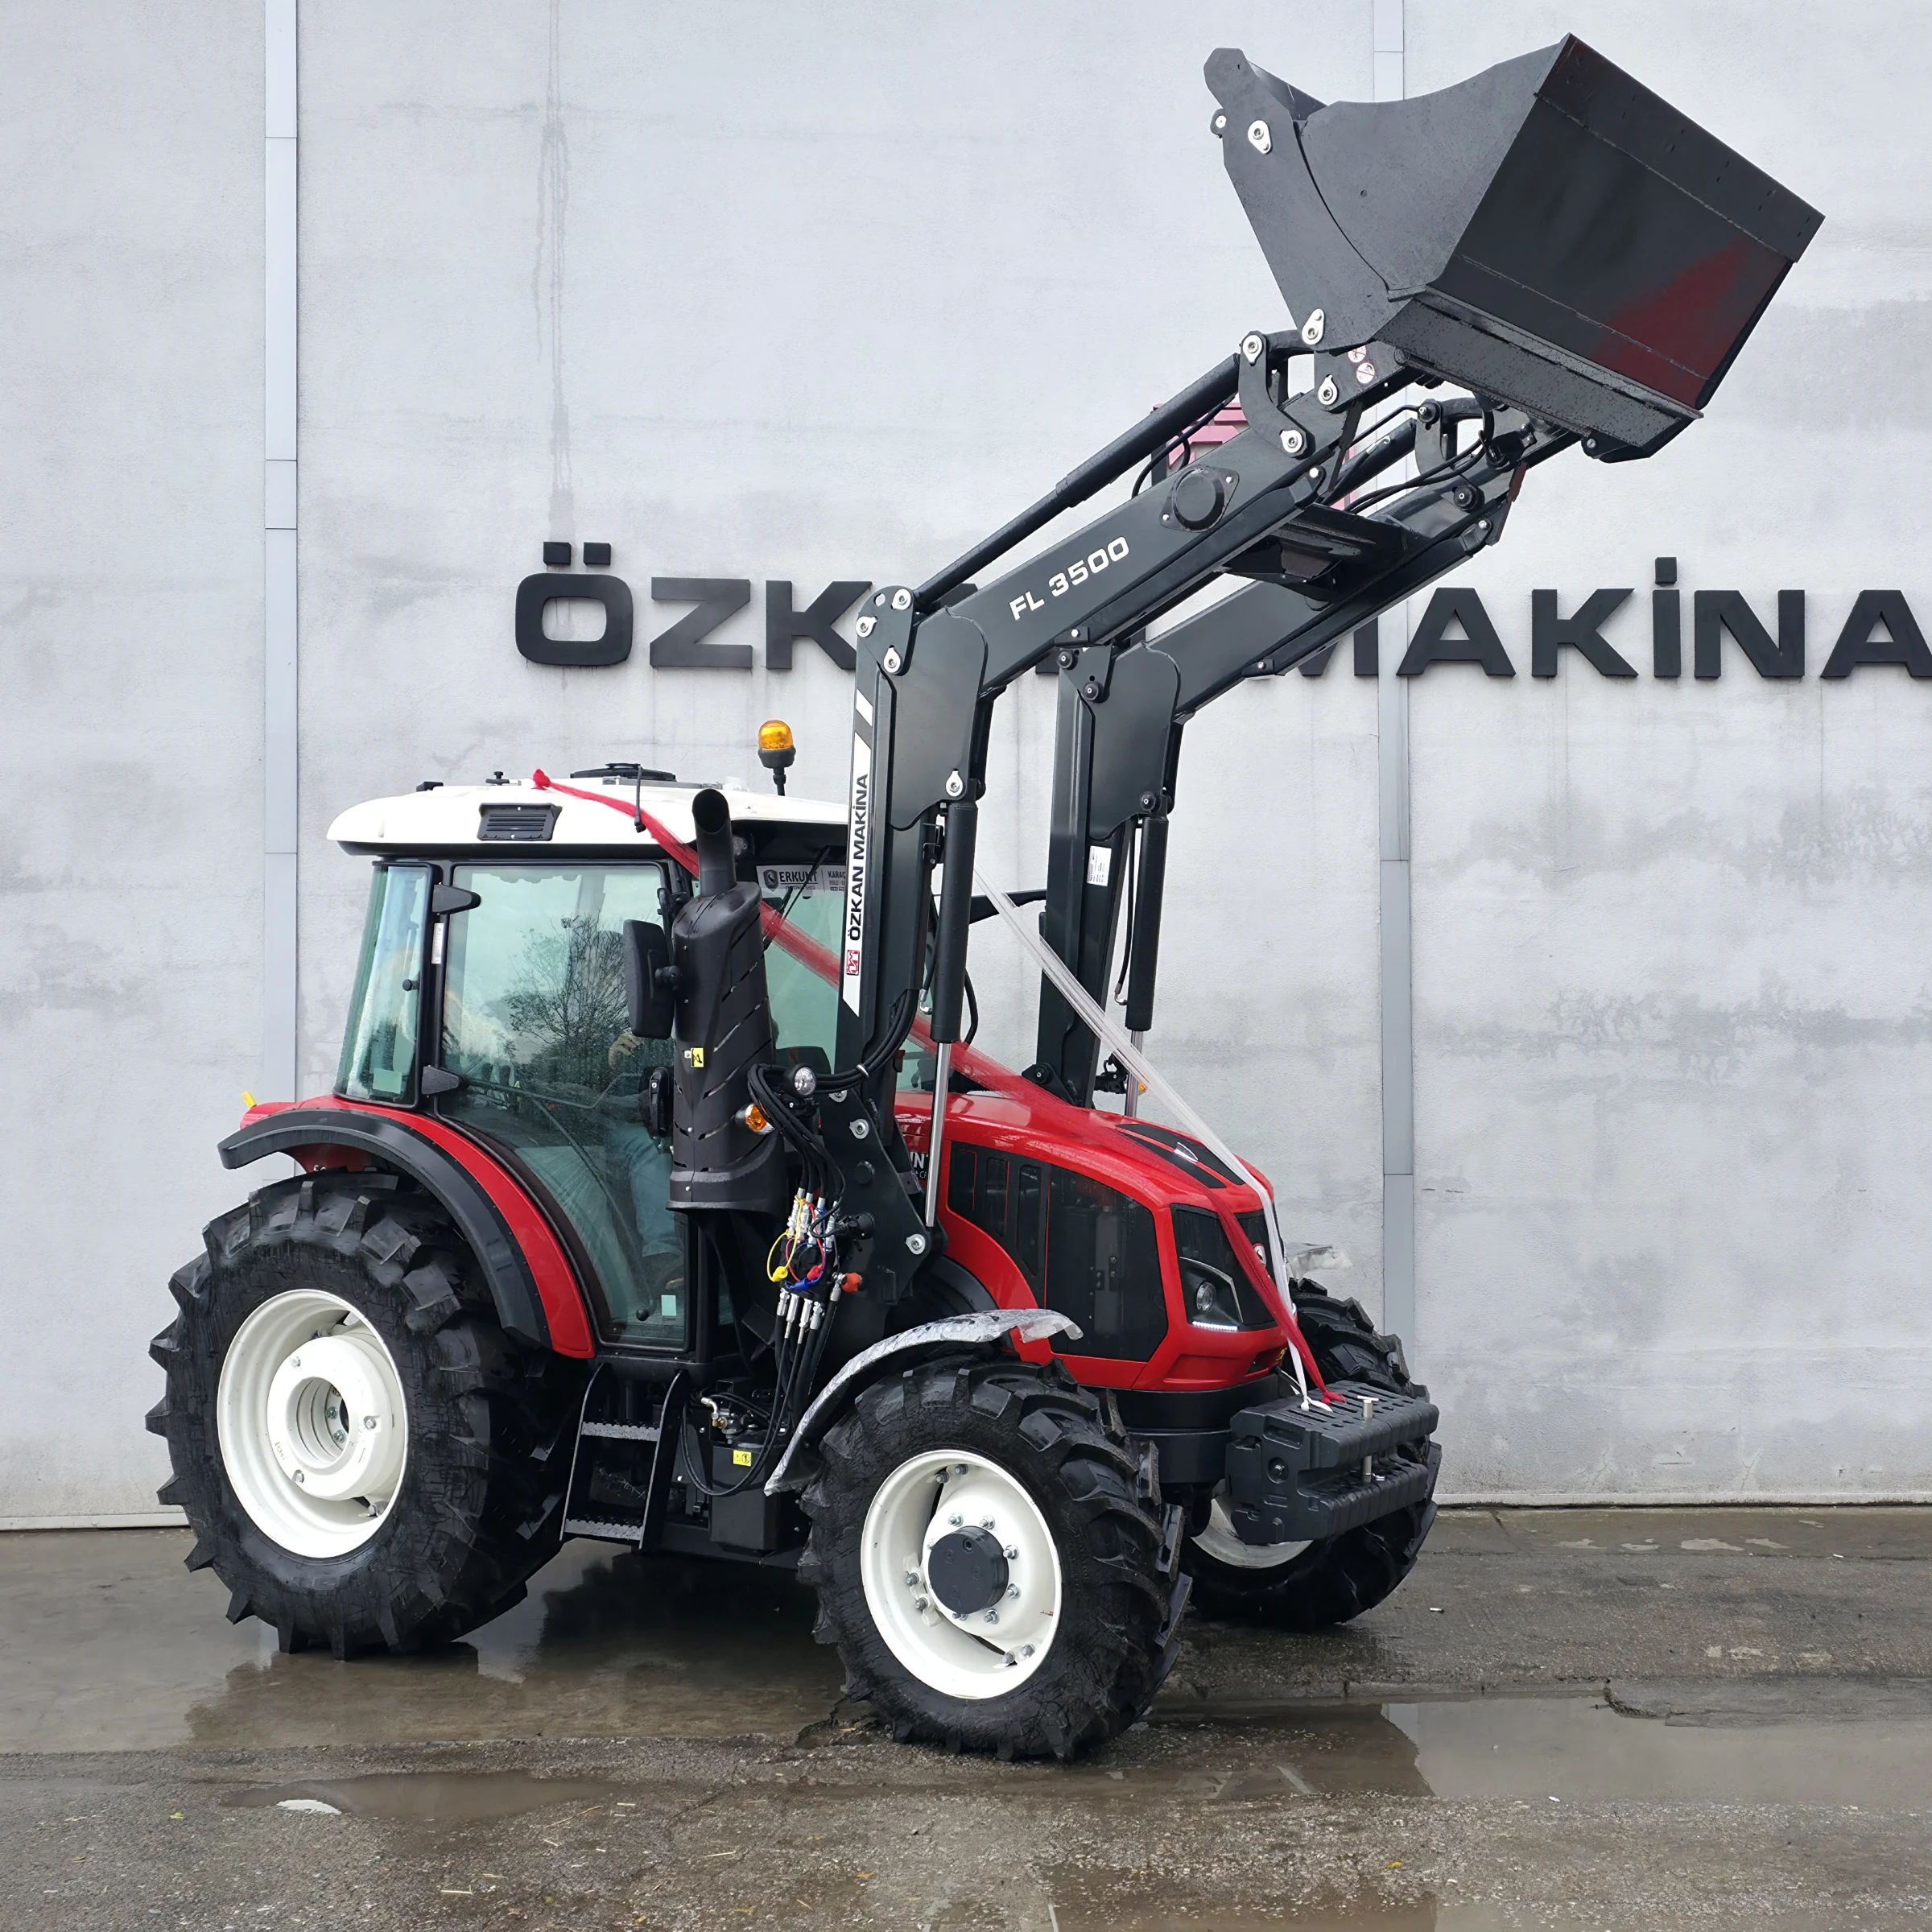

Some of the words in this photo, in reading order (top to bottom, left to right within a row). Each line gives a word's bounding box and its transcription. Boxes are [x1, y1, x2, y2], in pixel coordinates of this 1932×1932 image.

[515, 541, 1146, 675] ÖZK
[1009, 591, 1045, 621] FL
[1048, 536, 1129, 597] 3500
[852, 774, 868, 860] MAKİNA
[848, 866, 864, 940] ÖZKAN
